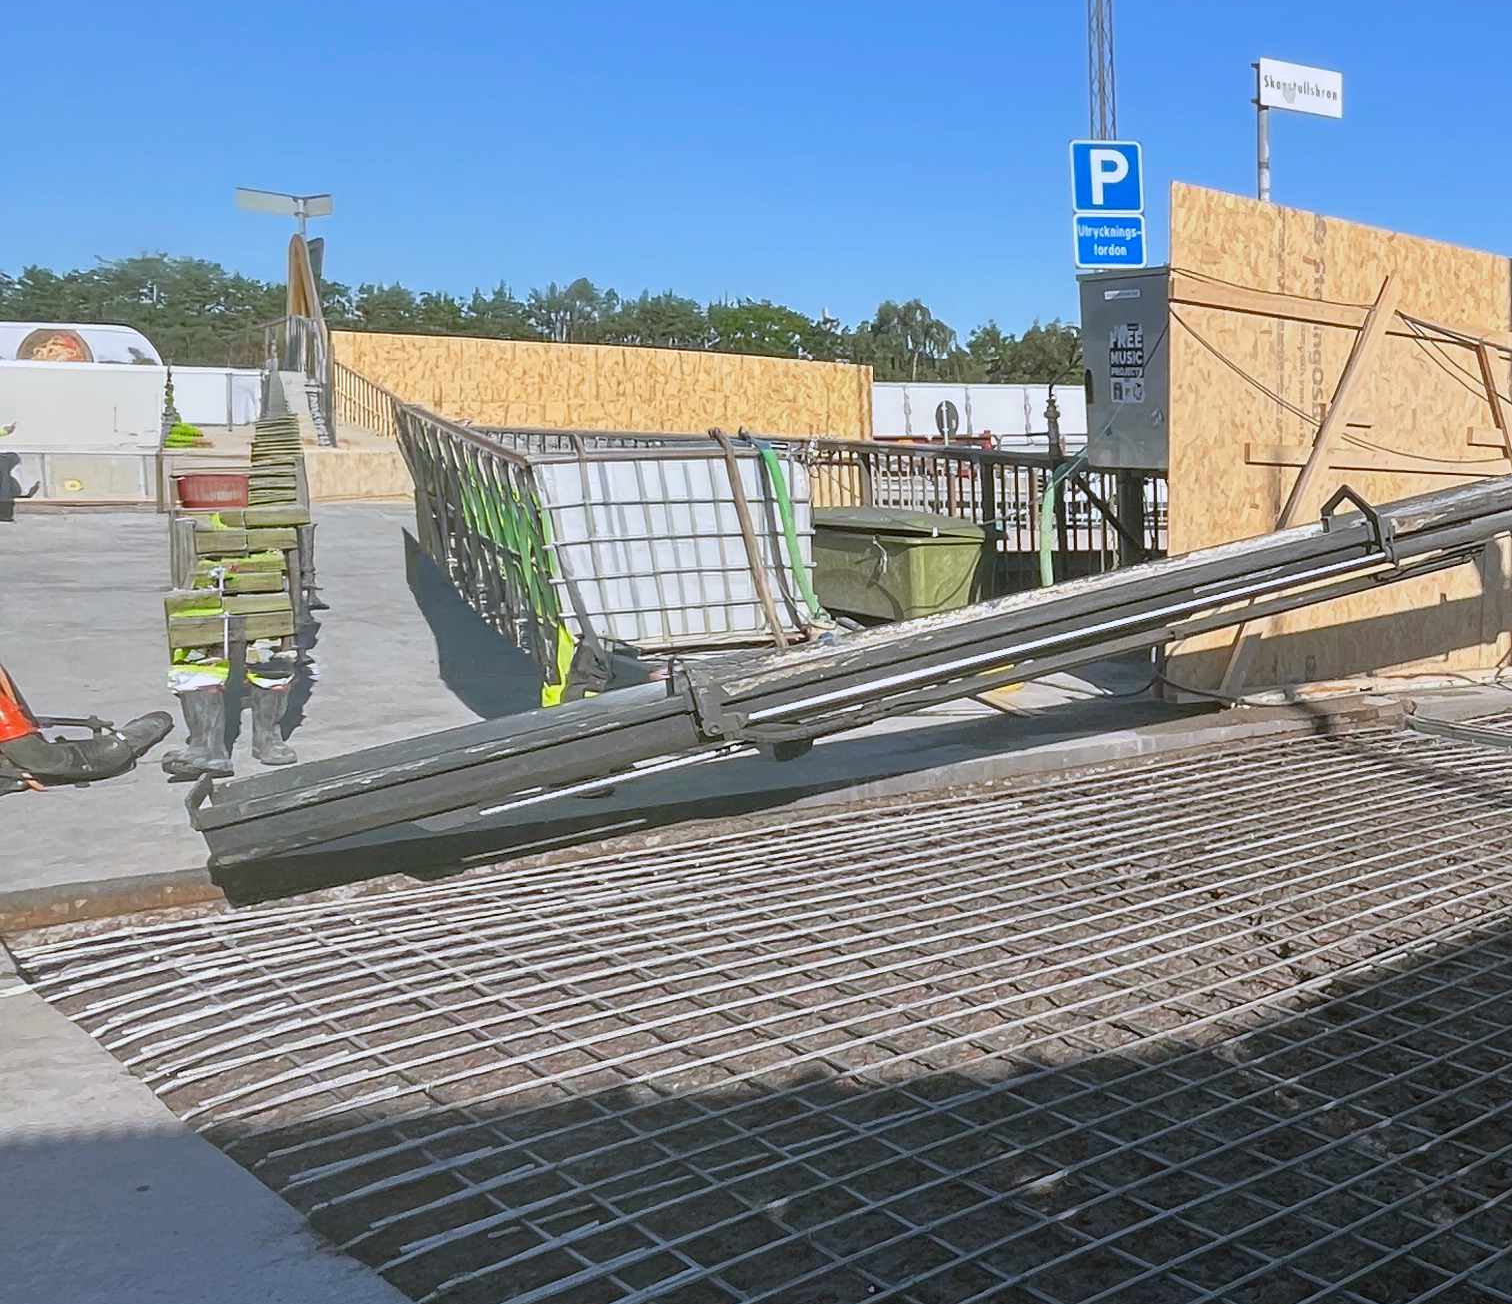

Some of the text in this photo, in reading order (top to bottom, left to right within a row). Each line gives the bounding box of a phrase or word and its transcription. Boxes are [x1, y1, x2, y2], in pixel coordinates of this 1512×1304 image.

[1089, 149, 1129, 206] P
[1109, 326, 1143, 349] FREE
[1110, 350, 1143, 365] MUSIC
